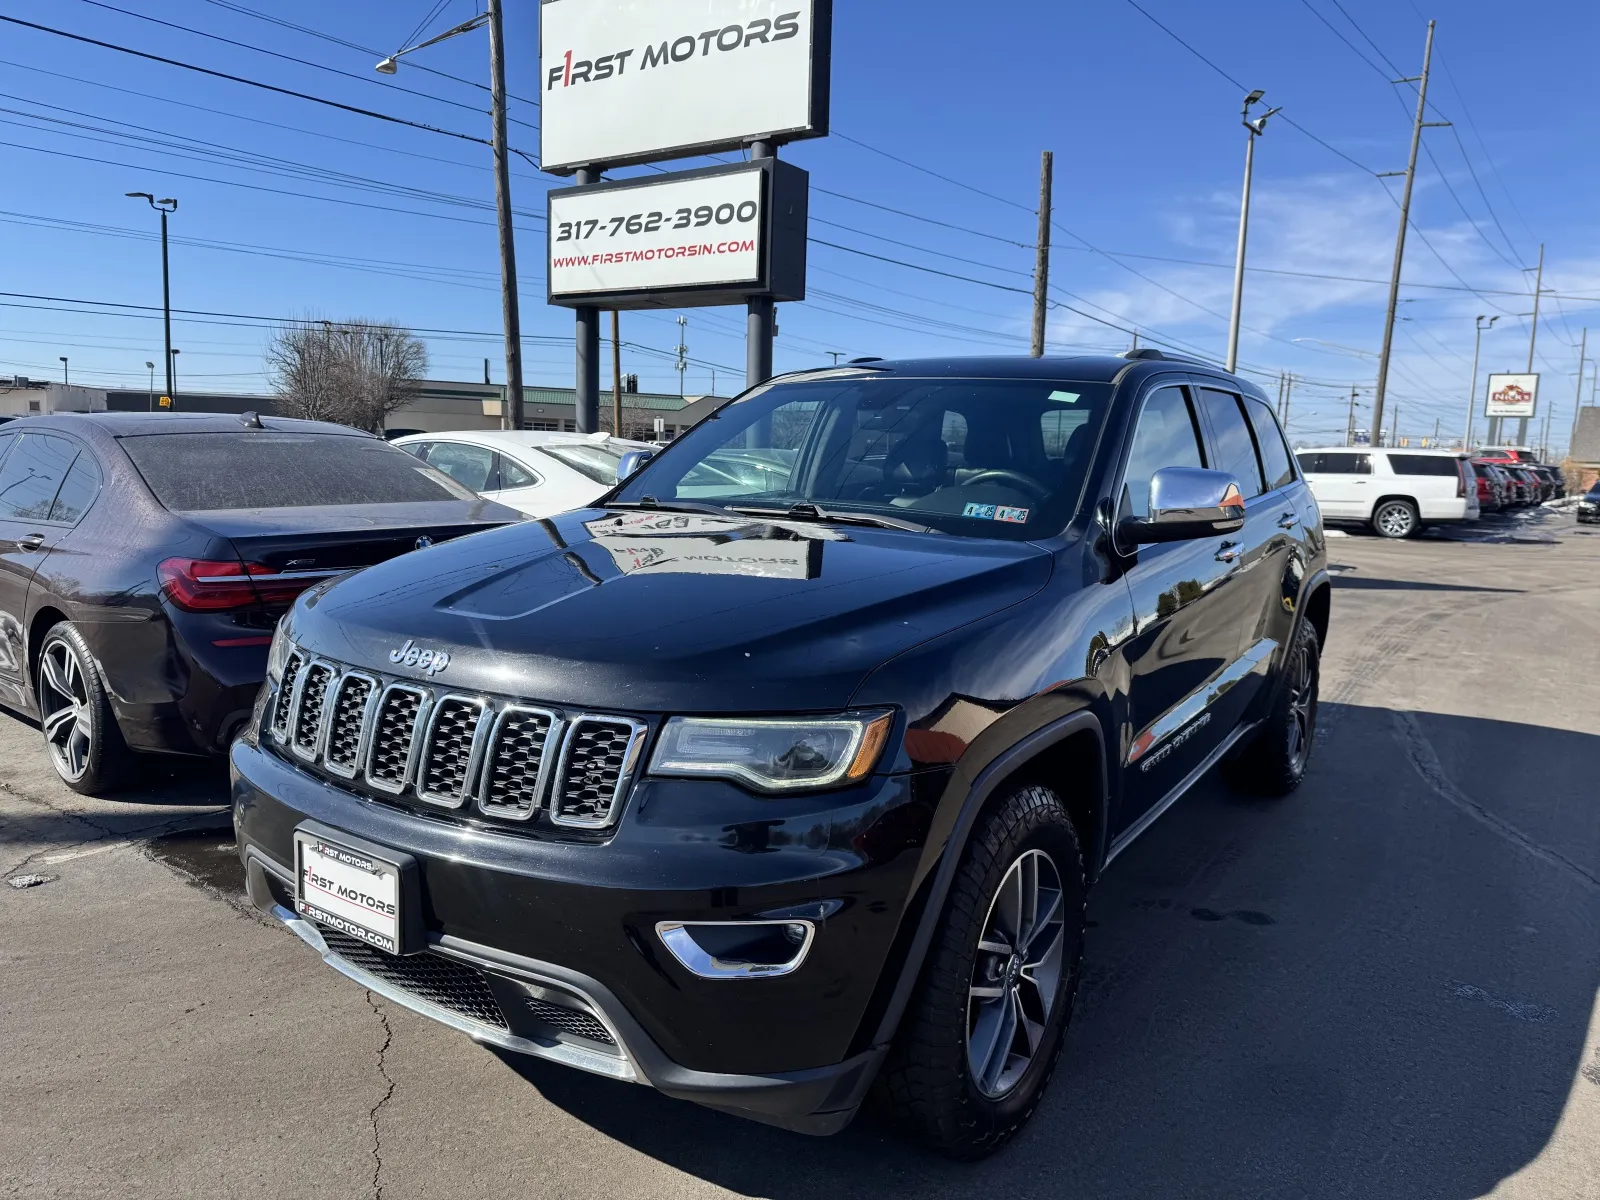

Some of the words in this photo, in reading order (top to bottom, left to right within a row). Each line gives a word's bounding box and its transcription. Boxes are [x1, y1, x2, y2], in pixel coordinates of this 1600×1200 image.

[640, 11, 801, 70] MOTORS
[556, 200, 757, 242] 317-762-3900
[553, 240, 754, 268] WWW.FIRSTMOTORSIN.COM
[389, 639, 450, 676] Jeep
[339, 853, 372, 870] MOTORS
[337, 884, 395, 915] MOTORS
